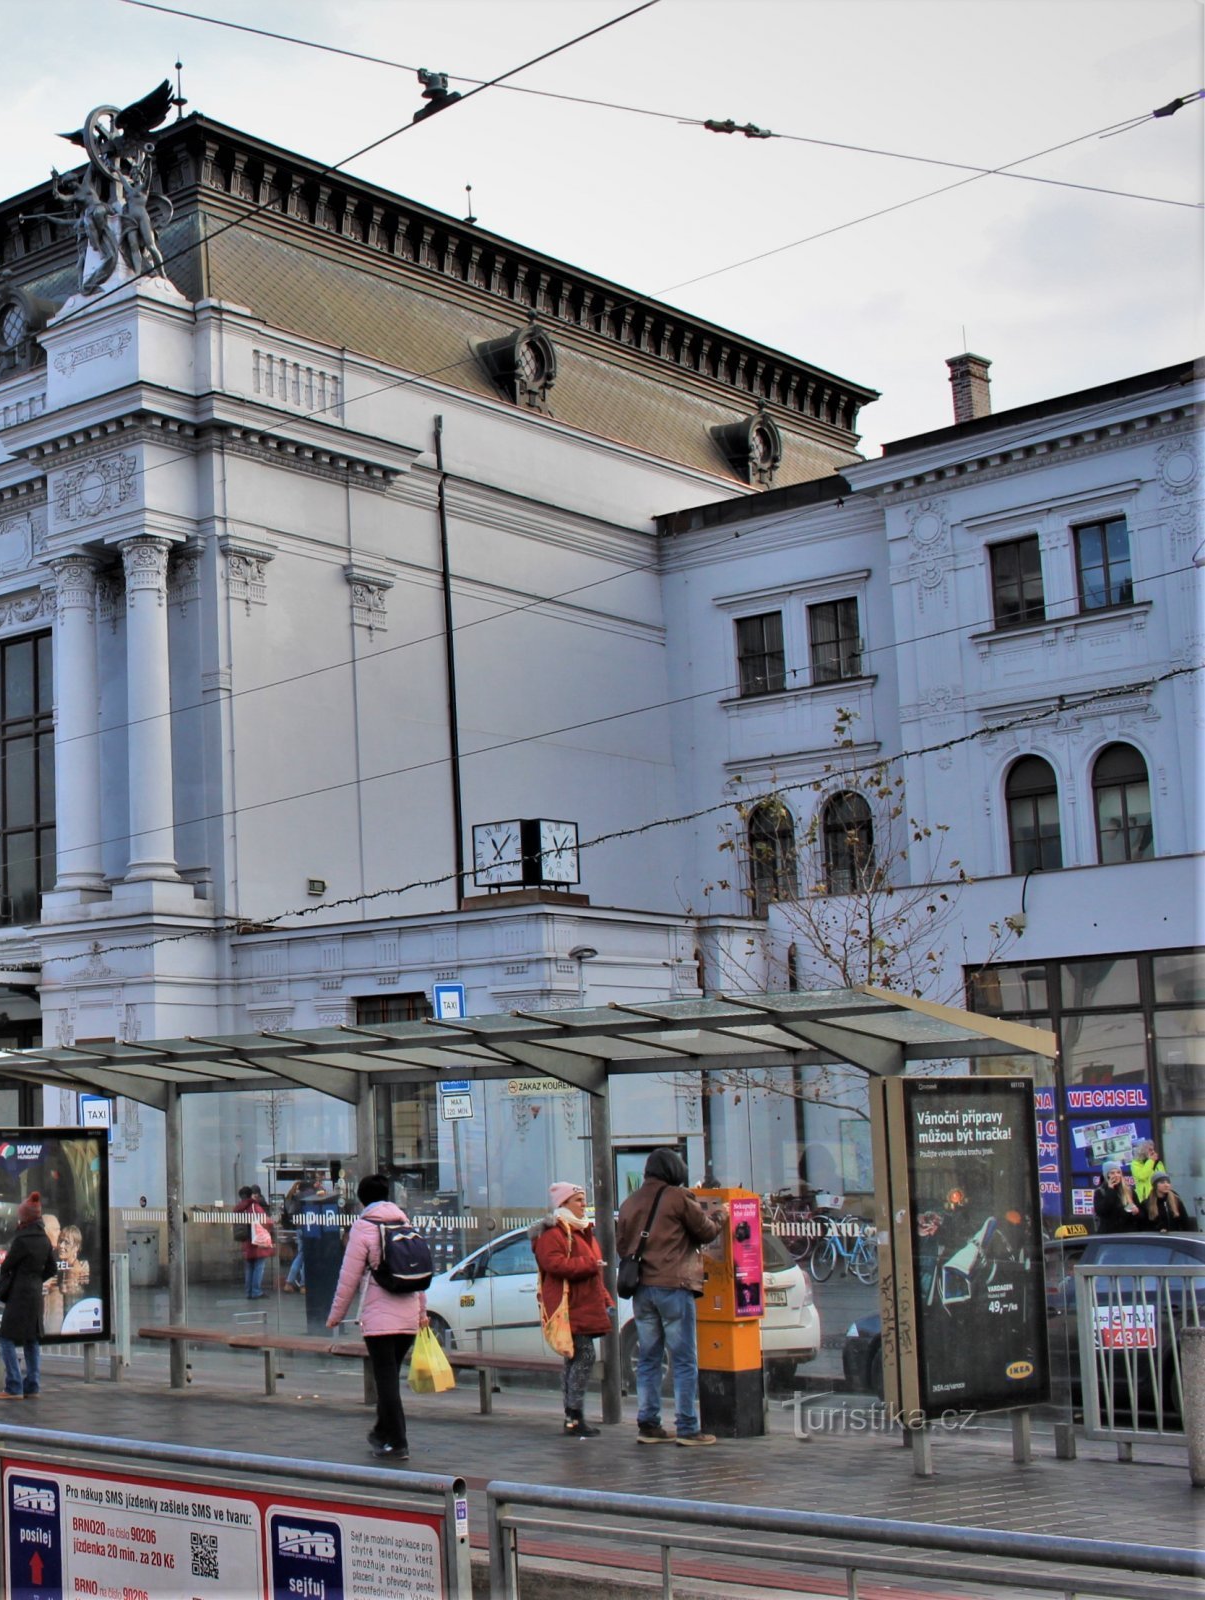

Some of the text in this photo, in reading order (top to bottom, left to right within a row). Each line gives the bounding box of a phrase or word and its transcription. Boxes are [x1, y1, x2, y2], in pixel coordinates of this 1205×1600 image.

[443, 1001, 458, 1010] TAXI
[1068, 1089, 1147, 1107] WECHSEL
[88, 1110, 107, 1120] TAXI
[917, 1109, 1003, 1126] Vánoční přípravy
[918, 1127, 1012, 1144] můžou být hračka!
[17, 1144, 43, 1155] WOW
[1069, 1224, 1086, 1235] TAXI
[987, 1283, 1013, 1293] VARDAGEN
[1008, 1364, 1031, 1376] IKEA
[66, 1485, 252, 1526] Pro nákup SMS jízdenky zašlete SMS ve tvaru:
[20, 1527, 52, 1548] posílej
[73, 1517, 156, 1544] BRNO20 na číslo 90206
[350, 1531, 433, 1553] Sejf je mobilní aplikace pro
[73, 1538, 175, 1569] jízdenka 20 min. za 20 Kč
[351, 1545, 434, 1566] chytré telefony, která
[351, 1559, 386, 1573] umožňuje
[74, 1577, 148, 1600] BRNO na číslo 90206
[289, 1576, 325, 1600] sejfuj
[352, 1570, 435, 1593] placení a převody peněz
[352, 1584, 405, 1600] prostřednictvím
